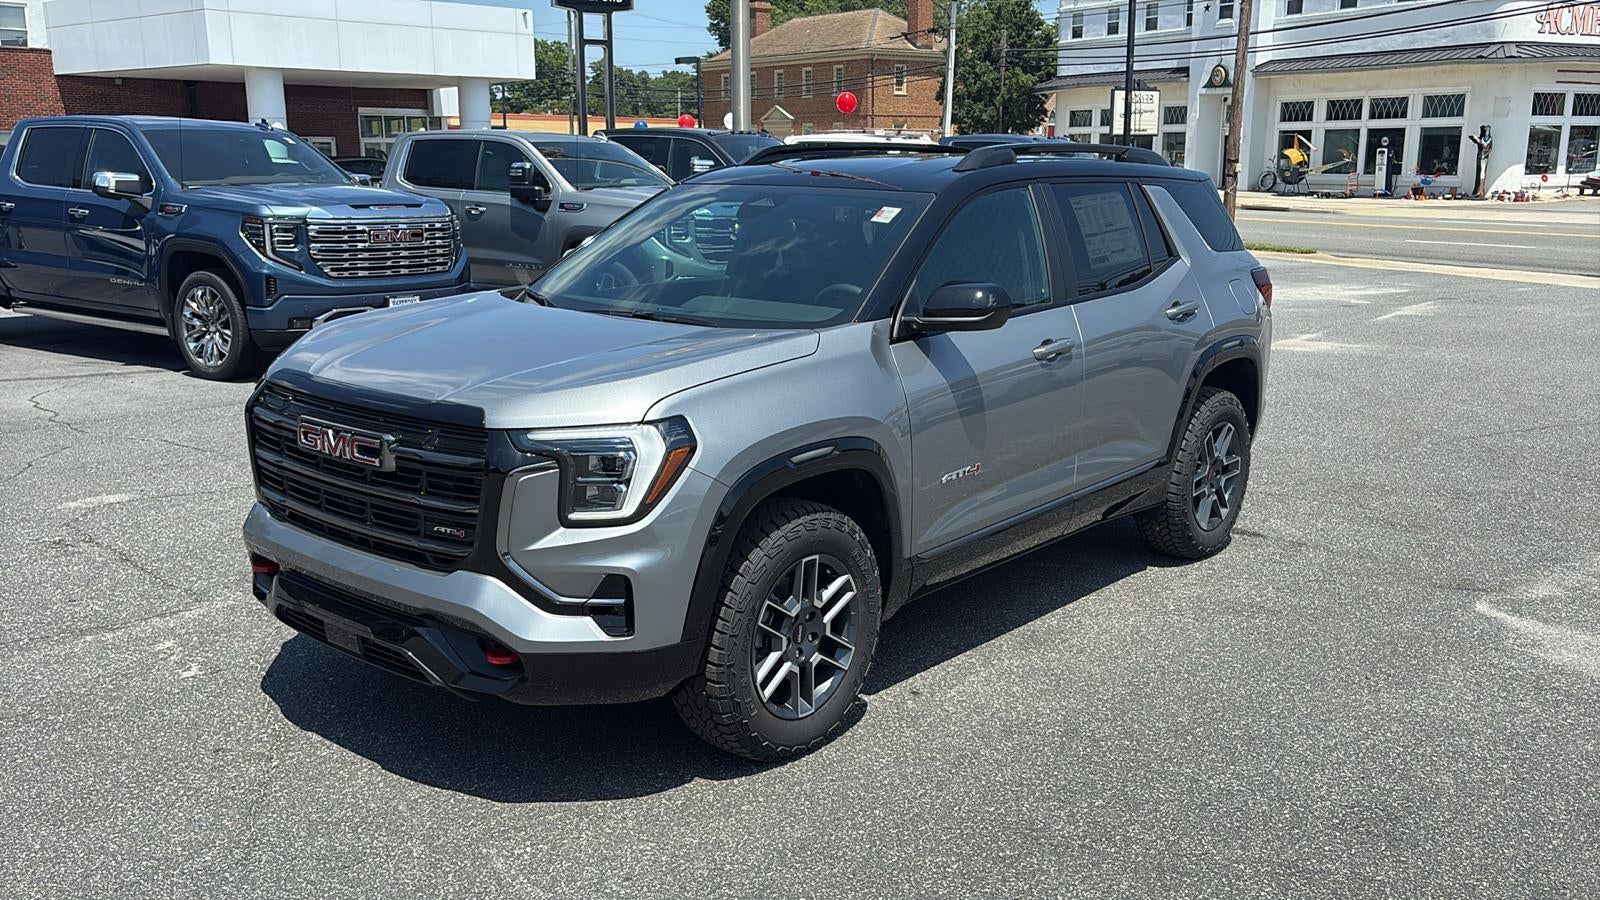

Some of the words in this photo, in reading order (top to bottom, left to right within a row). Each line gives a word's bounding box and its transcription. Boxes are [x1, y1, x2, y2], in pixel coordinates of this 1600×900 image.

[370, 229, 423, 243] GMC
[297, 422, 381, 467] GMC
[941, 462, 981, 484] AT4
[433, 526, 465, 538] AT4
